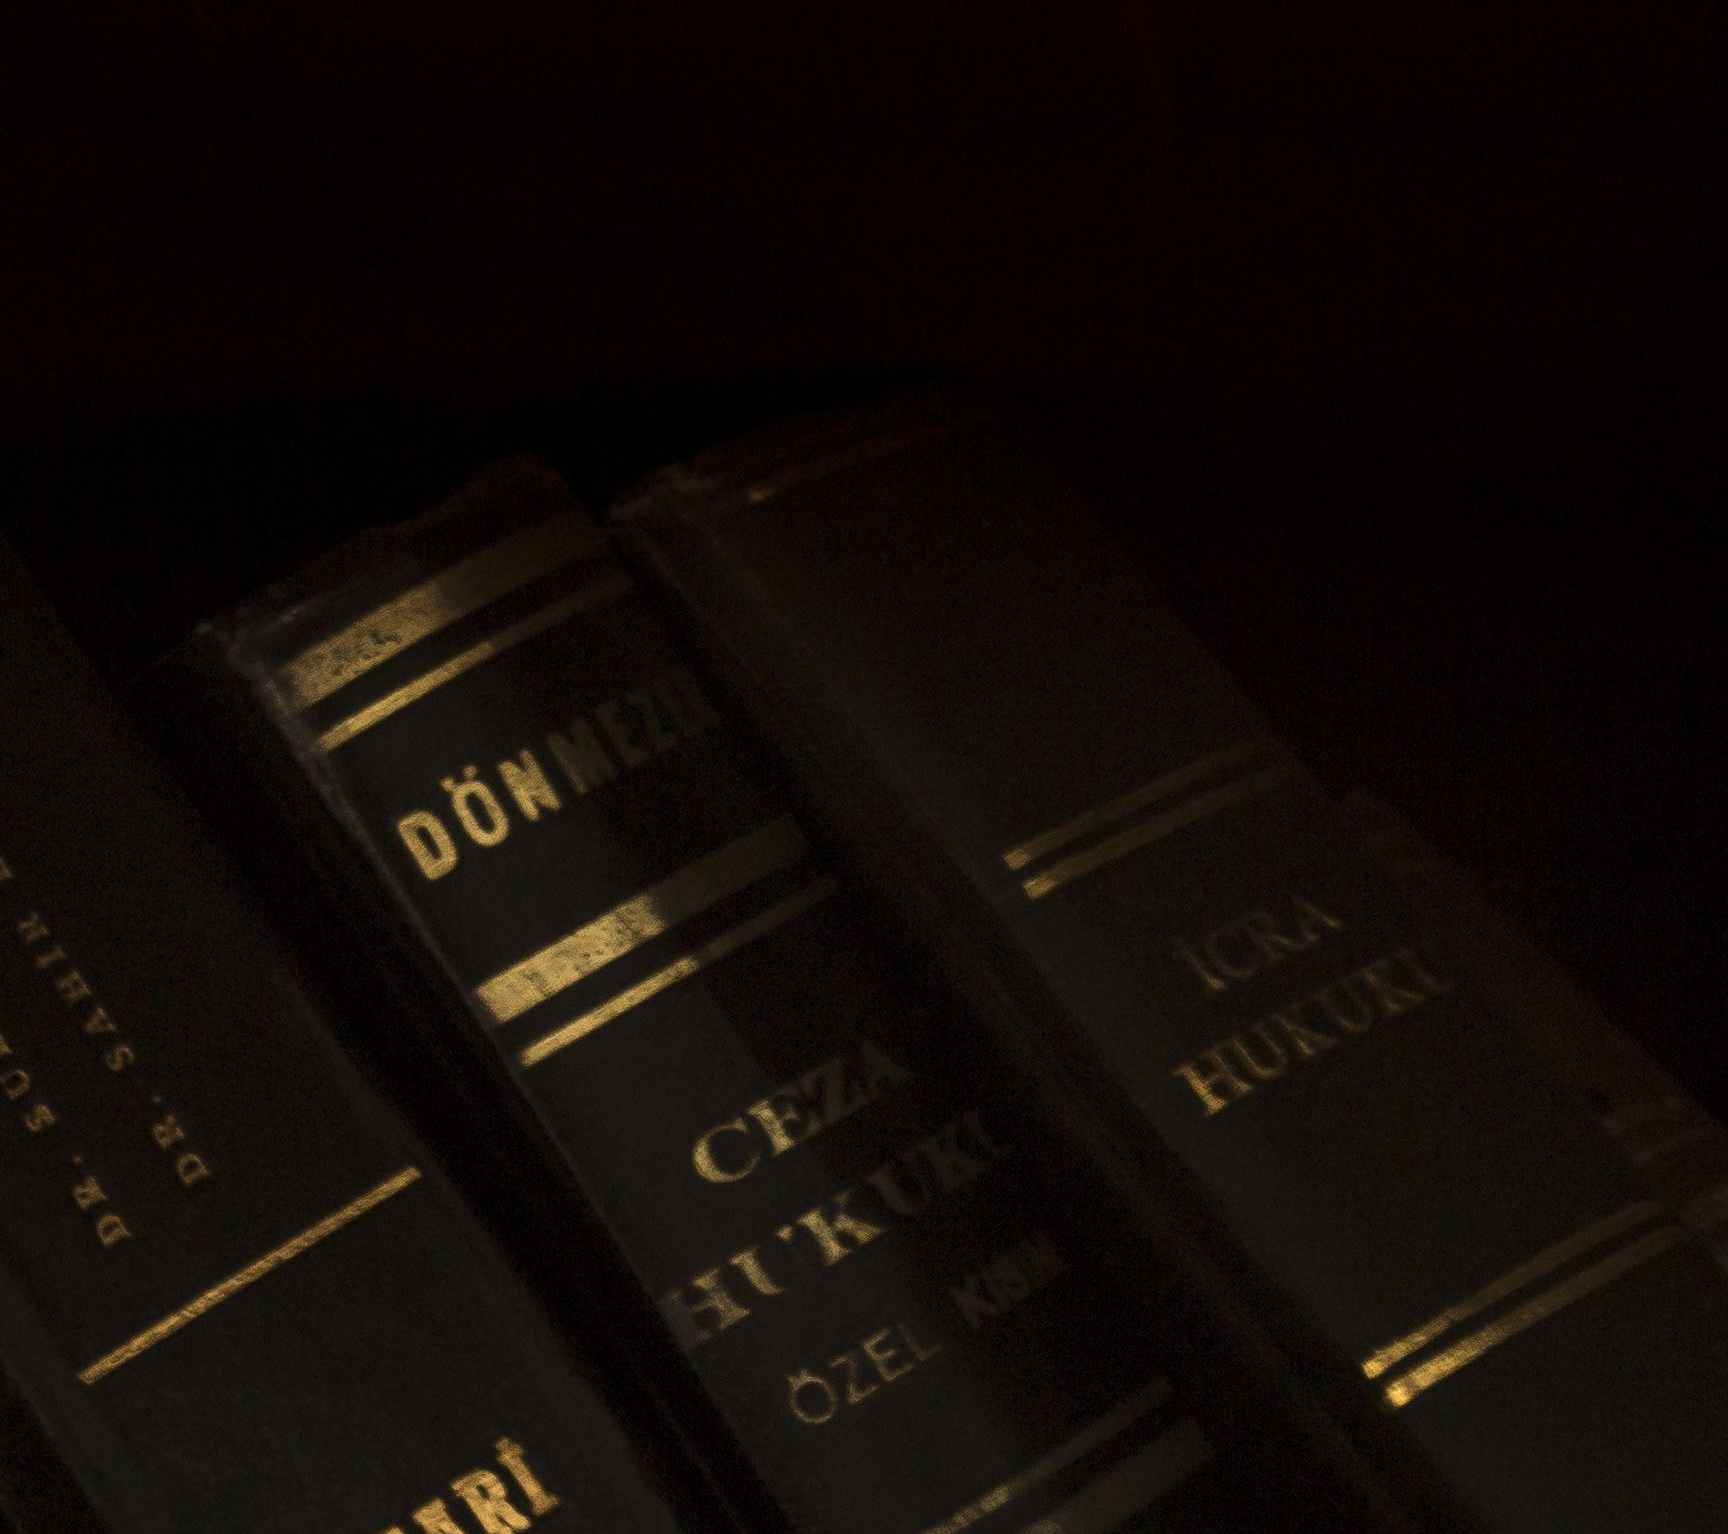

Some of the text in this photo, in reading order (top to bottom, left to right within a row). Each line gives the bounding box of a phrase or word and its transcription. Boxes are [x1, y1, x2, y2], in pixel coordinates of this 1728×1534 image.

[149, 1096, 211, 1186] DR.
[691, 1041, 912, 1184] CEZA
[71, 1155, 133, 1249] DR.
[786, 1322, 943, 1424] ÖZEL
